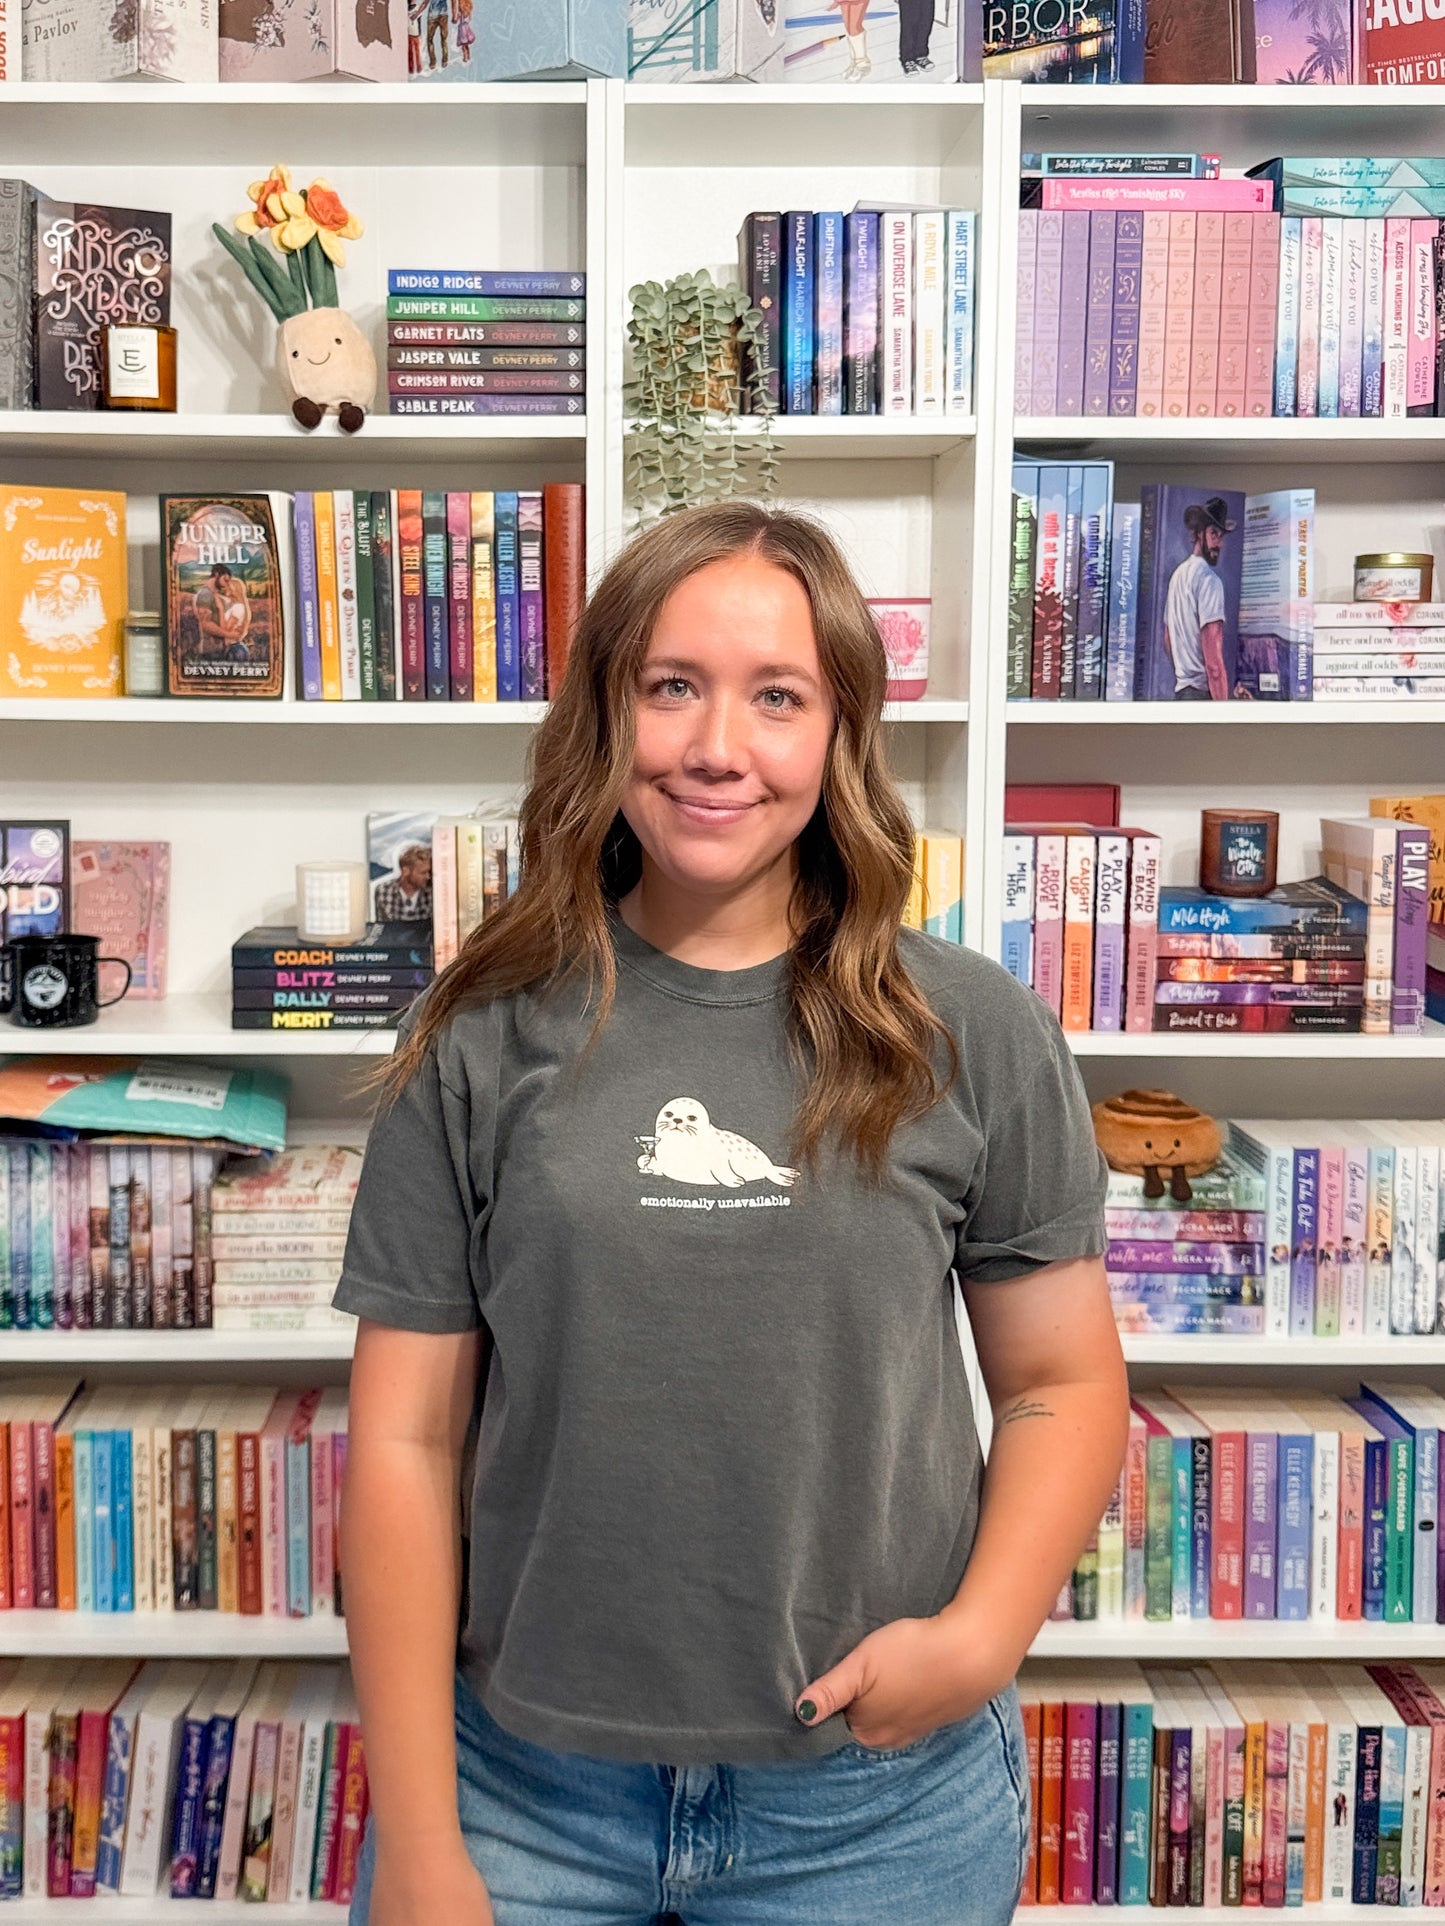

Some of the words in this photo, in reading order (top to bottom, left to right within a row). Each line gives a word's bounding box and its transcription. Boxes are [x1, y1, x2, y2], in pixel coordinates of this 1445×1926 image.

[34, 18, 79, 43] Pavlov
[1399, 51, 1442, 64] BESTSELLING
[893, 221, 905, 236] ON
[924, 222, 936, 230] A
[955, 221, 968, 248] HART
[795, 216, 806, 278] HALF-LIGHT
[824, 218, 835, 268] DRIFTING
[858, 218, 868, 270] TWILIGHT
[924, 232, 937, 263] ROYAL
[1395, 241, 1404, 269] ACROSS
[893, 238, 905, 290] LOVEROSE
[954, 250, 968, 286] STREET
[396, 276, 439, 289] INDIGO
[443, 276, 482, 289] RIDGE
[532, 280, 560, 290] PERRY
[923, 266, 936, 291] MILE
[395, 302, 447, 315] JUNIPER
[451, 302, 480, 315] HILL
[529, 306, 557, 316] PERRY
[795, 280, 805, 323] HARBOR
[893, 292, 905, 318] LANE
[954, 288, 967, 315] LANE
[1394, 283, 1403, 321] VANISHING
[394, 327, 443, 340] GARNET
[446, 327, 485, 340] FLATS
[1393, 323, 1402, 337] SKY
[397, 352, 444, 365] JASPER
[448, 352, 481, 365] VALE
[530, 356, 558, 366] PERRY
[793, 327, 802, 378] SAMANTHA
[892, 328, 902, 368] SAMANTHA
[953, 327, 963, 367] SAMANTHA
[397, 376, 447, 388] CRIMSON
[450, 376, 485, 388] RIVER
[892, 369, 902, 393] YOUNG
[953, 368, 962, 392] YOUNG
[1396, 354, 1405, 396] CATHERINE
[1420, 356, 1428, 398] CATHERINE
[397, 400, 438, 413] SABLE
[441, 400, 476, 413] PEAK
[793, 379, 801, 411] YOUNG
[822, 379, 831, 413] YOUNG
[854, 379, 864, 413] YOUNG
[357, 501, 368, 519] THE
[178, 522, 267, 545] JUNIPER
[357, 521, 372, 557] BLUFF
[427, 534, 444, 560] RIVEN
[498, 530, 514, 561] FALLEN
[21, 537, 103, 569] Sunlight
[197, 545, 250, 565] HILL
[300, 520, 312, 592] CROSSROADS
[320, 520, 332, 577] SUNLIGHT
[403, 545, 420, 572] STEEL
[452, 536, 467, 560] STONE
[475, 543, 490, 568] NOBLE
[522, 541, 540, 558] TIN
[403, 573, 420, 596] KING
[427, 562, 444, 598] KNIGHT
[452, 562, 467, 600] PRINCESS
[475, 569, 490, 600] PRINCE
[498, 562, 514, 595] JESTER
[522, 559, 540, 591] QUEEN
[407, 603, 417, 637] DEVNEY
[432, 605, 442, 639] DEVNEY
[456, 605, 466, 639] DEVNEY
[502, 602, 512, 637] DEVNEY
[527, 605, 536, 639] DEVNEY
[362, 618, 372, 657] DEVNEY
[1329, 635, 1352, 646] here
[1354, 635, 1372, 646] and
[407, 639, 417, 667] PERRY
[432, 641, 442, 668] PERRY
[456, 641, 466, 668] PERRY
[502, 639, 512, 666] PERRY
[527, 641, 536, 669] PERRY
[1361, 661, 1373, 671] all
[1374, 661, 1399, 671] odds
[184, 666, 231, 677] DEVNEY
[233, 667, 270, 677] PERRY
[363, 659, 374, 690] PERRY
[1229, 826, 1262, 836] STELLA
[1016, 862, 1027, 894] MILE
[1112, 859, 1123, 895] PLAY
[1236, 860, 1257, 876] City
[1402, 841, 1427, 891] PLAY
[1006, 873, 1017, 907] HIGH
[1039, 863, 1050, 903] MOVE
[1049, 869, 1060, 911] RIGHT
[1069, 876, 1079, 895] UP
[1079, 857, 1091, 914] CAUGHT
[1100, 863, 1111, 914] ALONG
[1133, 876, 1145, 911] BACK
[1144, 858, 1157, 914] REWIND
[1171, 909, 1199, 927] Mile
[1199, 908, 1231, 928] High
[273, 950, 334, 966] COACH
[276, 971, 336, 988] BLITZ
[273, 991, 332, 1008] RALLY
[272, 1011, 334, 1029] MERIT
[1299, 1154, 1315, 1175] The
[640, 1196, 715, 1211] emotionally
[718, 1195, 791, 1208] unavailable
[1297, 1202, 1312, 1235] Out
[1195, 1443, 1208, 1468] ON
[1221, 1443, 1235, 1468] ELLE
[1253, 1442, 1267, 1468] ELLE
[1287, 1447, 1300, 1474] ELLE
[1397, 1443, 1407, 1469] LOVE
[1195, 1471, 1208, 1507] THIN
[1219, 1470, 1234, 1522] KENNEDY
[1252, 1470, 1267, 1523] KENNEDY
[1286, 1475, 1299, 1528] KENNEDY
[1396, 1471, 1406, 1532] OVERBOARD
[1129, 1474, 1143, 1550] DECISION
[1193, 1508, 1207, 1532] ICE
[1071, 1738, 1081, 1780] WALSH
[1081, 1737, 1092, 1780] CHLOE
[1109, 1739, 1118, 1777] CHLOE
[1128, 1737, 1137, 1779] WALSH
[1137, 1737, 1148, 1780] CHLOE
[1363, 1734, 1378, 1767] Paper
[1173, 1769, 1187, 1790] My
[1336, 1760, 1350, 1788] Play
[1175, 1791, 1187, 1819] Name
